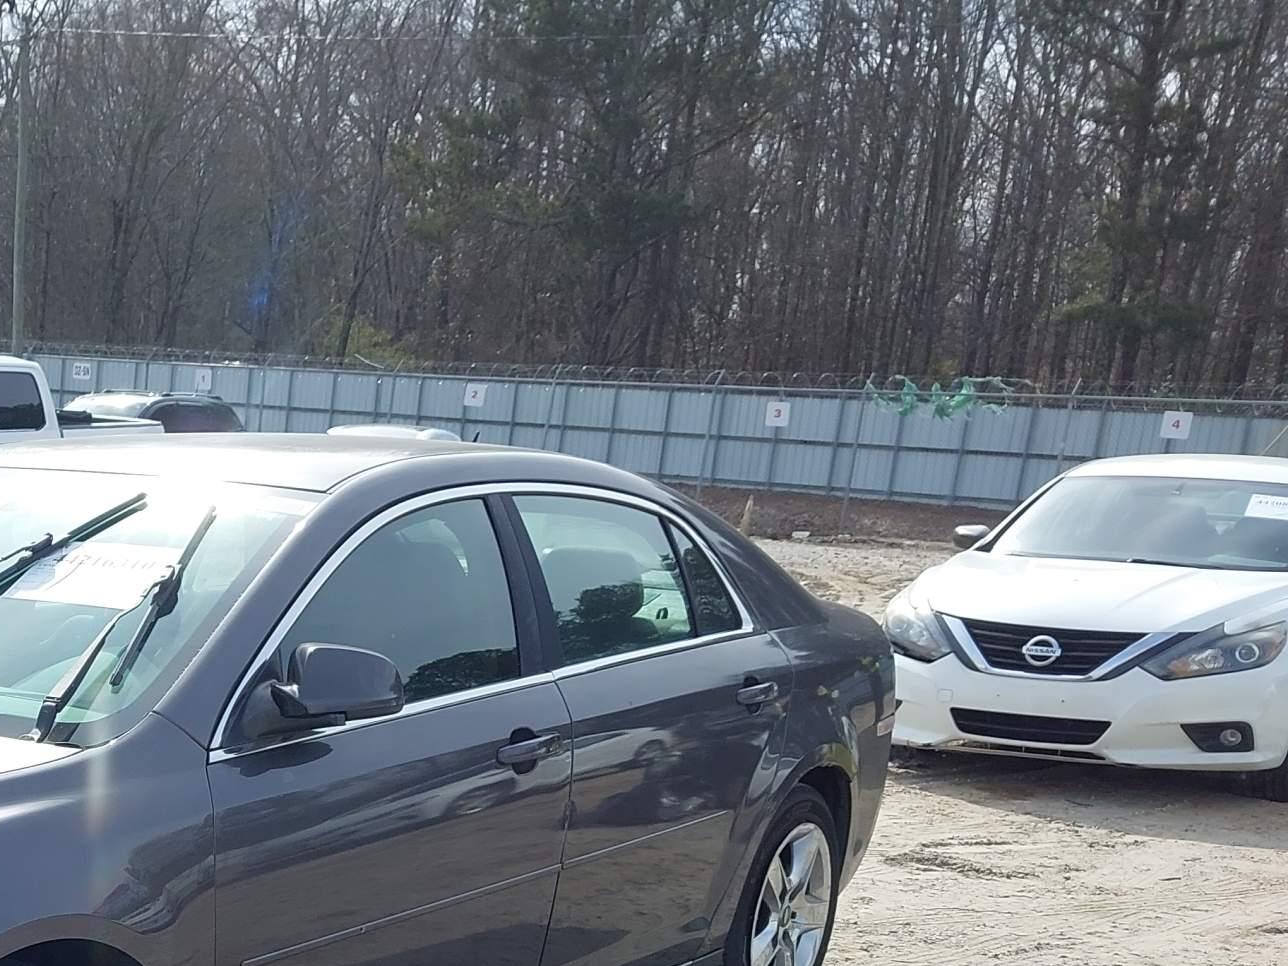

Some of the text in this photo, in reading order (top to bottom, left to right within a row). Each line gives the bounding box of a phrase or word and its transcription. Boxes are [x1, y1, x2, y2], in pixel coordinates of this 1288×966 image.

[471, 390, 478, 400] 2
[774, 408, 782, 418] 3
[1171, 419, 1180, 430] 4
